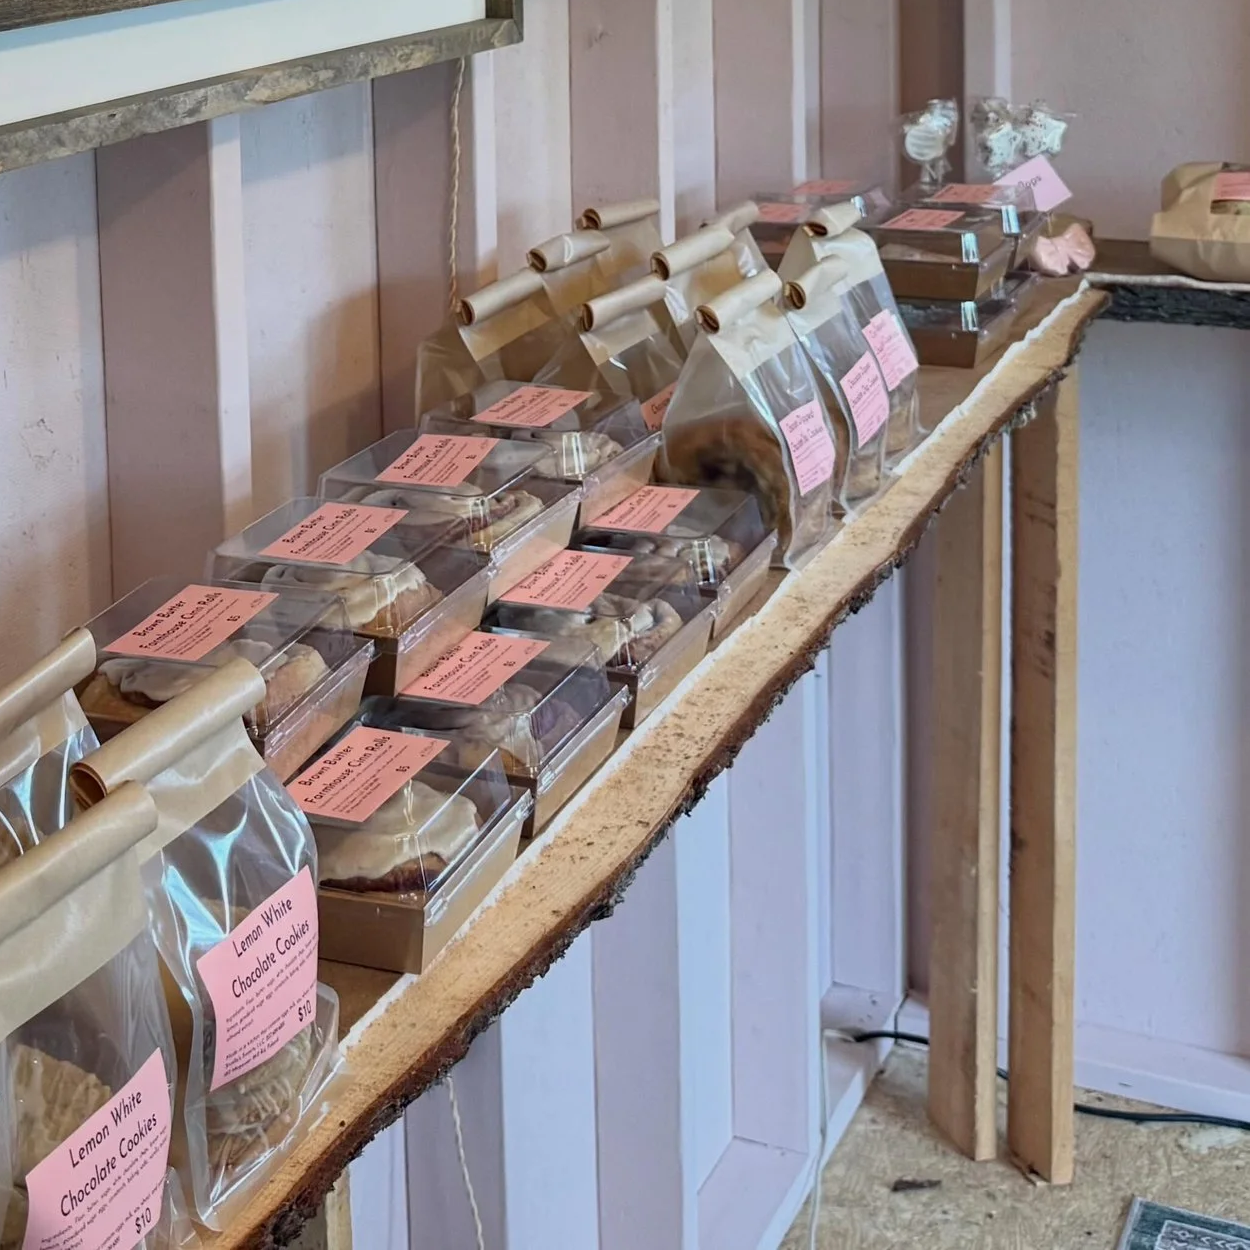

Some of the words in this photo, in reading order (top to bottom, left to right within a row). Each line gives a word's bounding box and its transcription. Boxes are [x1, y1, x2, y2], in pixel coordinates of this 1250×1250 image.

[132, 615, 164, 638] Brown
[157, 600, 186, 619] Butter
[139, 619, 187, 650] Farmhouse
[180, 605, 206, 620] Cinn
[198, 592, 222, 607] Rolls
[298, 764, 331, 787] Brown
[323, 744, 354, 766] Butter
[304, 767, 354, 804] Farmhouse
[347, 750, 374, 768] Cinn
[365, 735, 392, 753] Rolls
[233, 924, 263, 958] Lemon
[260, 898, 293, 928] White
[232, 951, 277, 998] Chocolate
[275, 919, 310, 956] Cookies
[298, 999, 312, 1022] $10
[68, 1124, 110, 1168] Lemon
[110, 1091, 142, 1127] White
[60, 1155, 117, 1217] Chocolate
[118, 1113, 158, 1159] Cookies
[135, 1207, 152, 1234] $10
